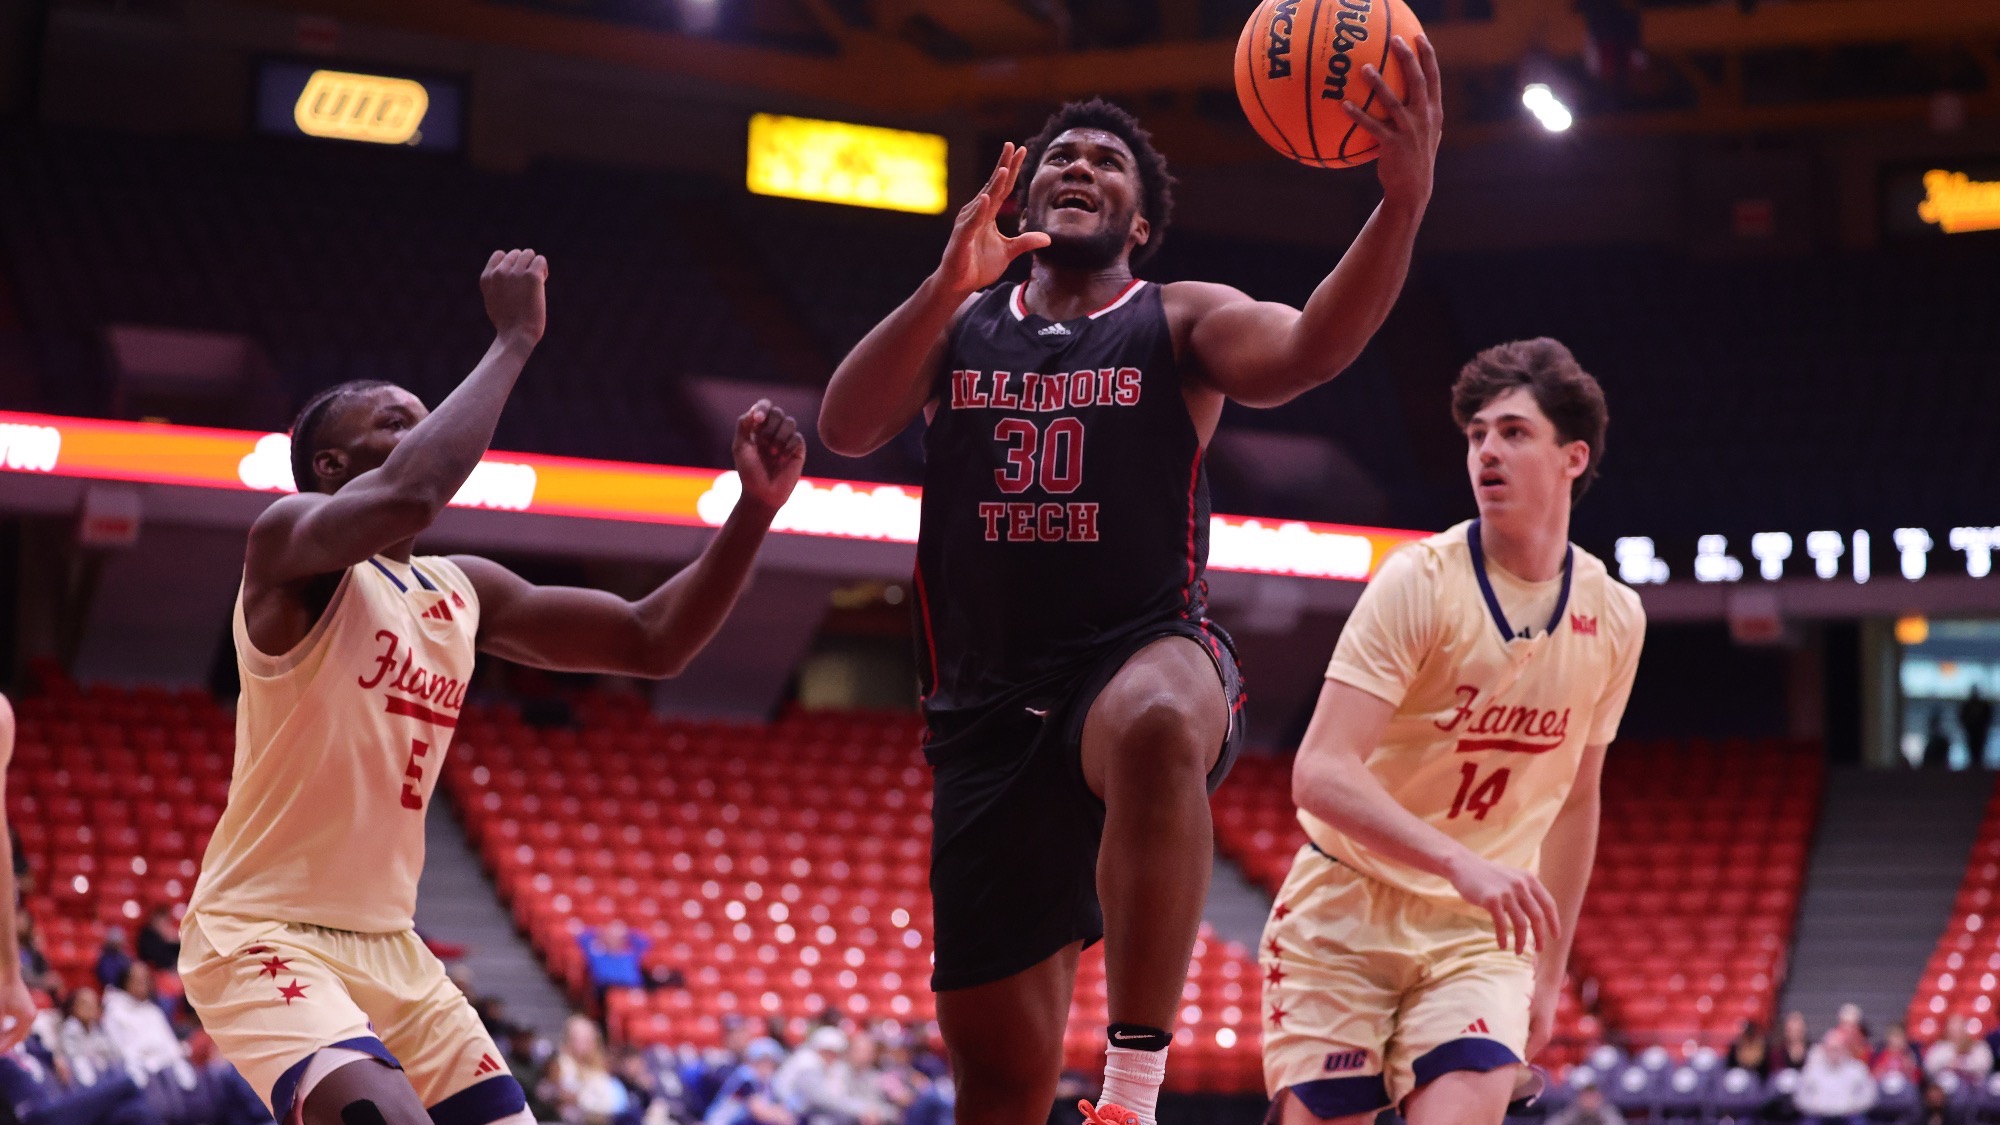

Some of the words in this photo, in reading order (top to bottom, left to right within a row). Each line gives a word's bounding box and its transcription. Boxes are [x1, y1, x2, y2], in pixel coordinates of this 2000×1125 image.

[951, 367, 1142, 412] ILLINOIS
[994, 416, 1085, 494] 30
[979, 502, 1099, 542] TECH
[358, 629, 466, 711] Flame
[1433, 684, 1571, 738] Fames
[400, 738, 430, 811] 5
[1447, 762, 1511, 821] 14
[1323, 1048, 1369, 1074] UIC
